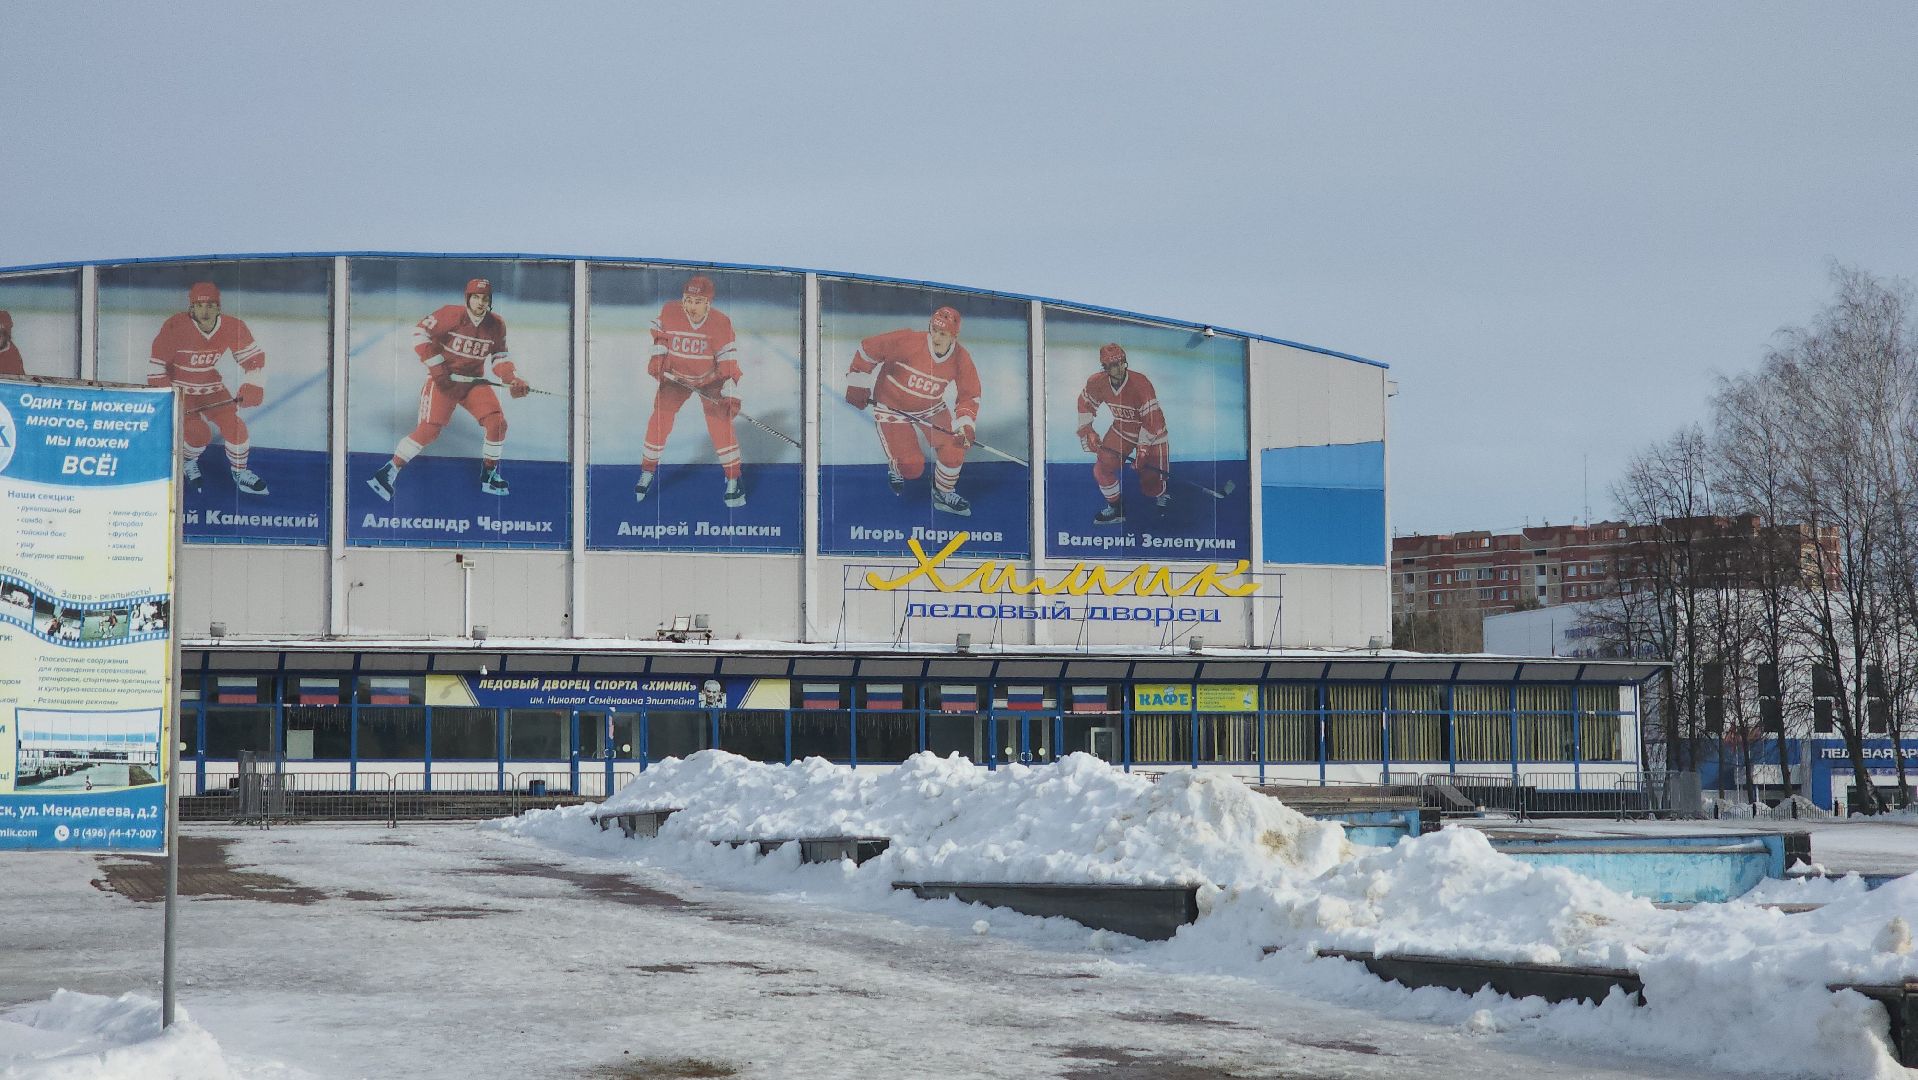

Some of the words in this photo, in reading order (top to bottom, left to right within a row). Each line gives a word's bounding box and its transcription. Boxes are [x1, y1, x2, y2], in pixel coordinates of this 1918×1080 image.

[452, 336, 490, 357] СССР
[672, 336, 709, 352] СССР
[190, 353, 222, 366] СССР
[908, 374, 940, 394] СССР
[20, 393, 62, 410] Один
[67, 399, 87, 412] ты
[91, 402, 156, 414] можешь
[26, 415, 89, 431] многое,
[93, 419, 149, 432] вместе
[45, 434, 71, 446] мы
[75, 437, 129, 449] можем
[62, 453, 119, 477] ВСЁ!
[7, 490, 36, 500] Наши
[38, 493, 75, 502] секции:
[206, 510, 319, 528] Каменский
[362, 513, 470, 532] Александр
[477, 515, 553, 533] Черных
[617, 521, 689, 539] Андрей
[694, 521, 781, 538] Ломакин
[850, 525, 905, 542] Игорь
[910, 526, 1003, 543] Ларинов
[1058, 531, 1136, 549] Валерий
[1142, 533, 1236, 551] Зелепукин
[866, 531, 1263, 597] Химик
[60, 588, 92, 600] Завтра
[99, 586, 152, 600] реальность!
[907, 601, 1071, 621] ледовый
[1086, 603, 1222, 627] дворец
[479, 677, 539, 691] ЛЕДОВЫЙ
[541, 679, 590, 692] ДВОРЕЦ
[594, 680, 638, 691] СПОРТА
[642, 680, 697, 692] «ХИМИК»
[530, 696, 545, 704] им.
[547, 695, 586, 704] Николая
[588, 695, 644, 705] Семёновича
[645, 696, 695, 706] Эпштейна
[1138, 692, 1189, 706] КАФЕ
[1821, 747, 1894, 759] ЛЕДВАЯ
[19, 806, 39, 819] ул.
[43, 803, 135, 819] Менделеева,
[137, 805, 158, 819] д.2
[73, 828, 80, 837] 8
[82, 828, 107, 839] (496)
